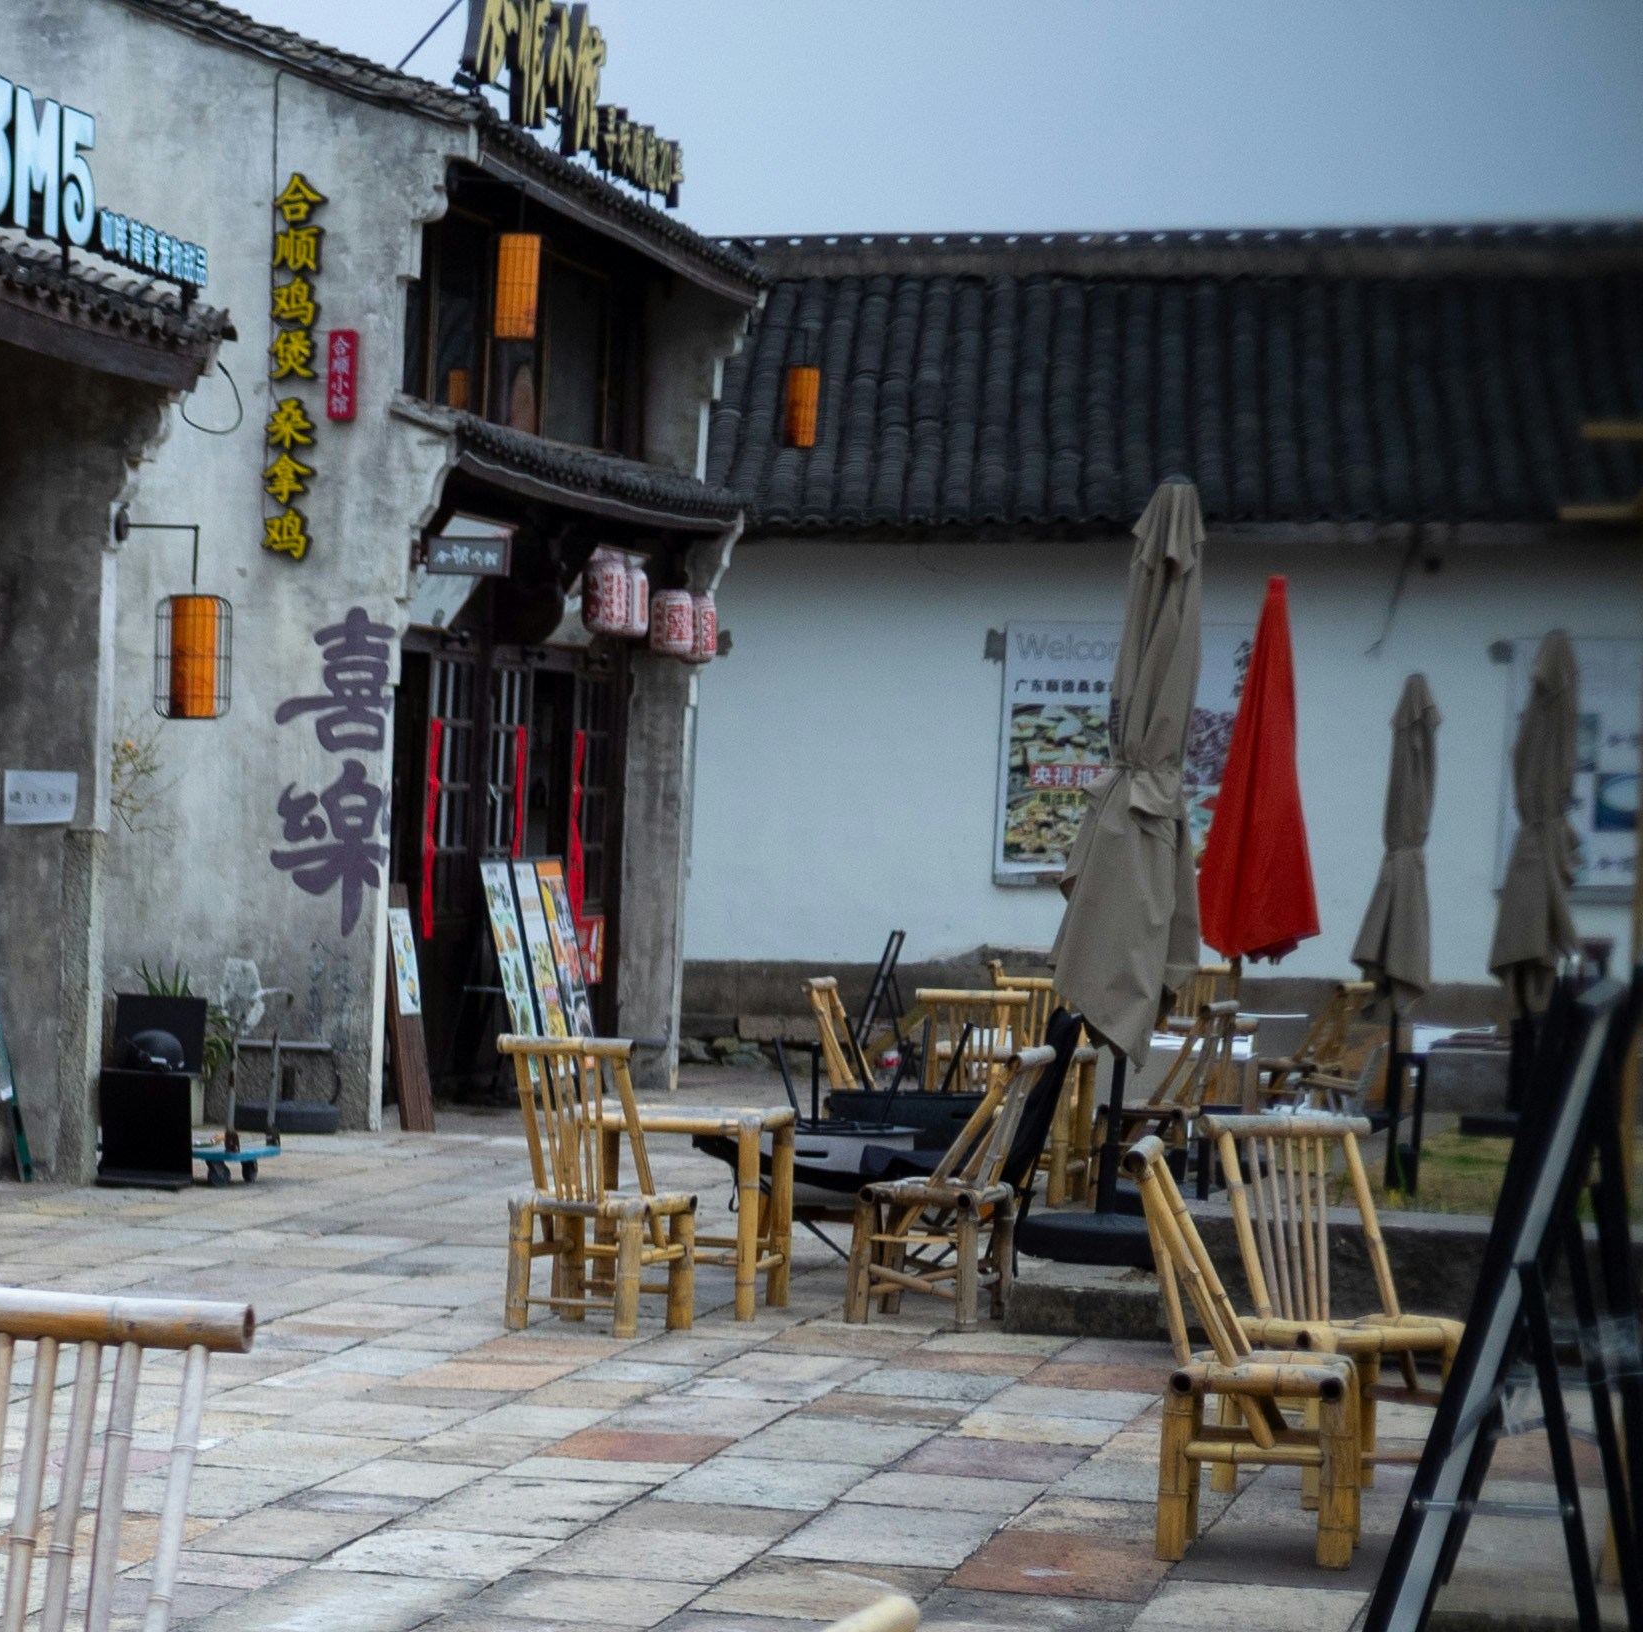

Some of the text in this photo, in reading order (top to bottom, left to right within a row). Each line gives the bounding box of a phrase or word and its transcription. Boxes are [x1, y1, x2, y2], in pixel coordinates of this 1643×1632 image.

[262, 172, 328, 560] 合顺鸡煲 桑拿鸡
[331, 335, 352, 415] 合顺小馆
[1016, 632, 1121, 660] Welco
[1014, 679, 1113, 693] 广东顺德桑拿
